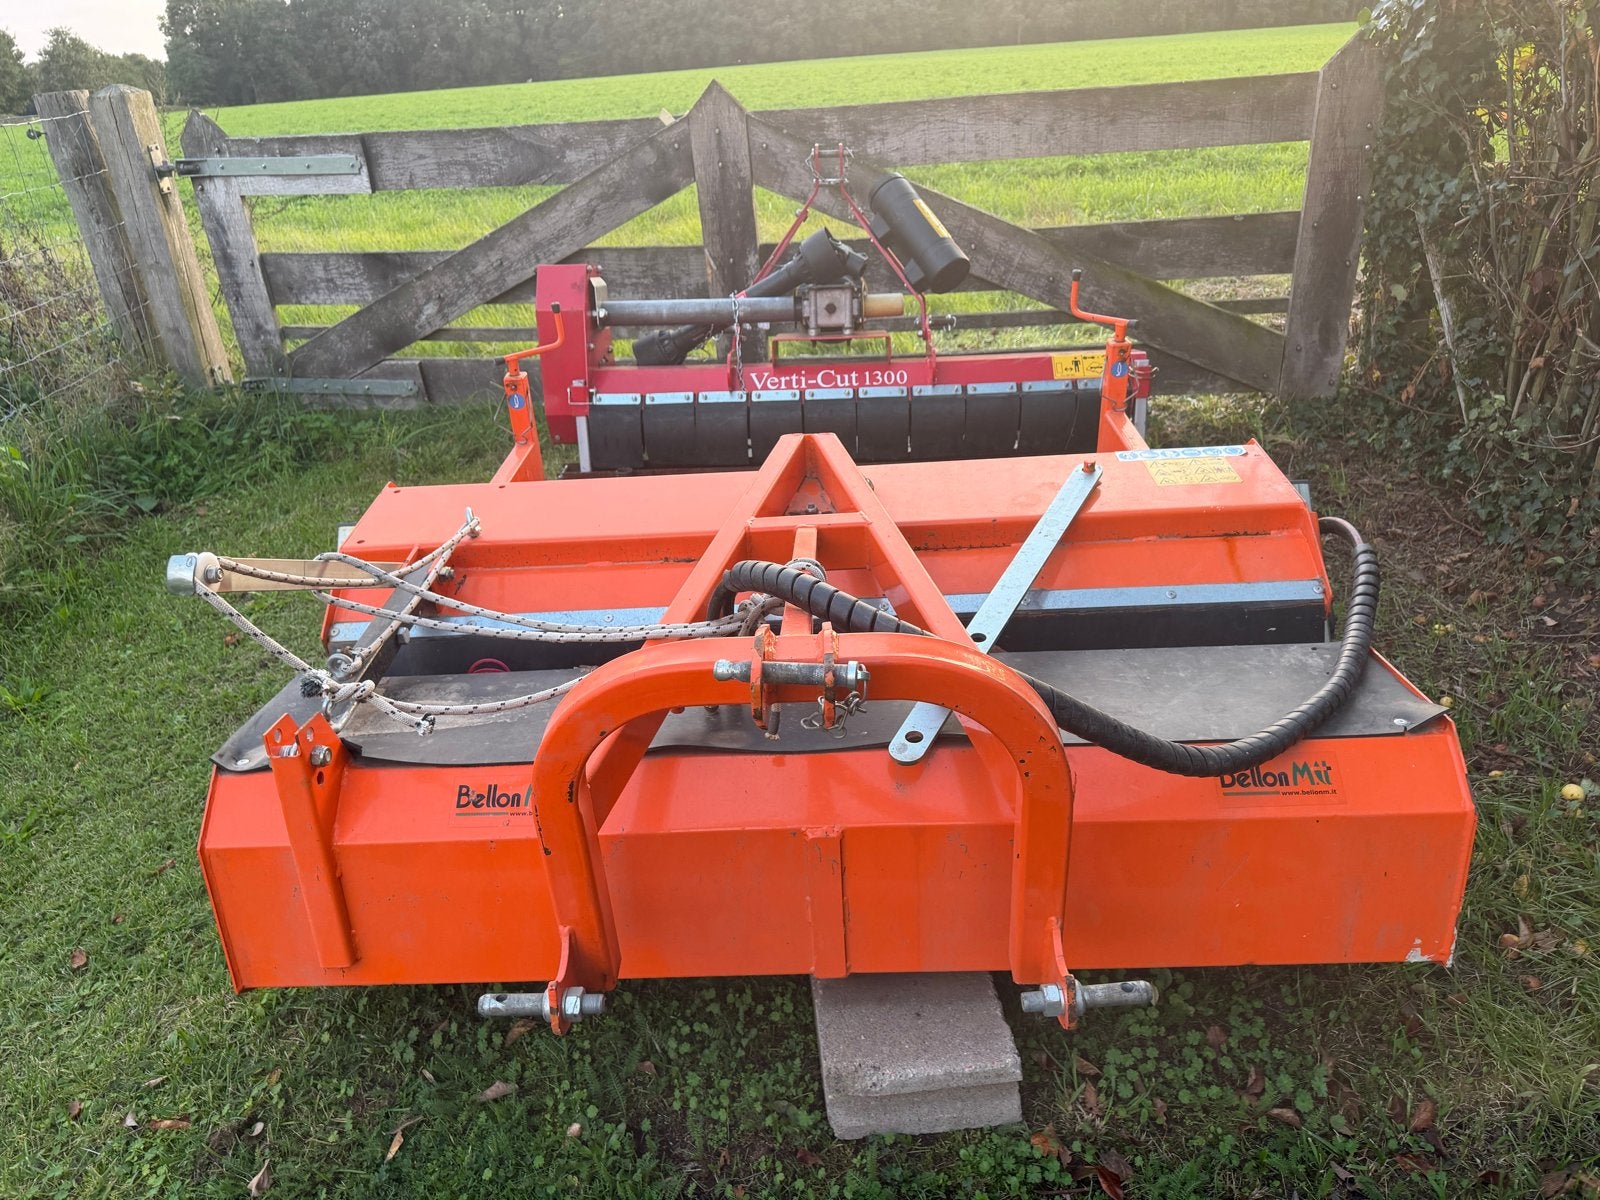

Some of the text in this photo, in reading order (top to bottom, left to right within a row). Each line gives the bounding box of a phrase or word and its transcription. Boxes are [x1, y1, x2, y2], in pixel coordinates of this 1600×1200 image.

[750, 370, 908, 389] Verti-Cut 1300
[456, 784, 521, 808] Bellon
